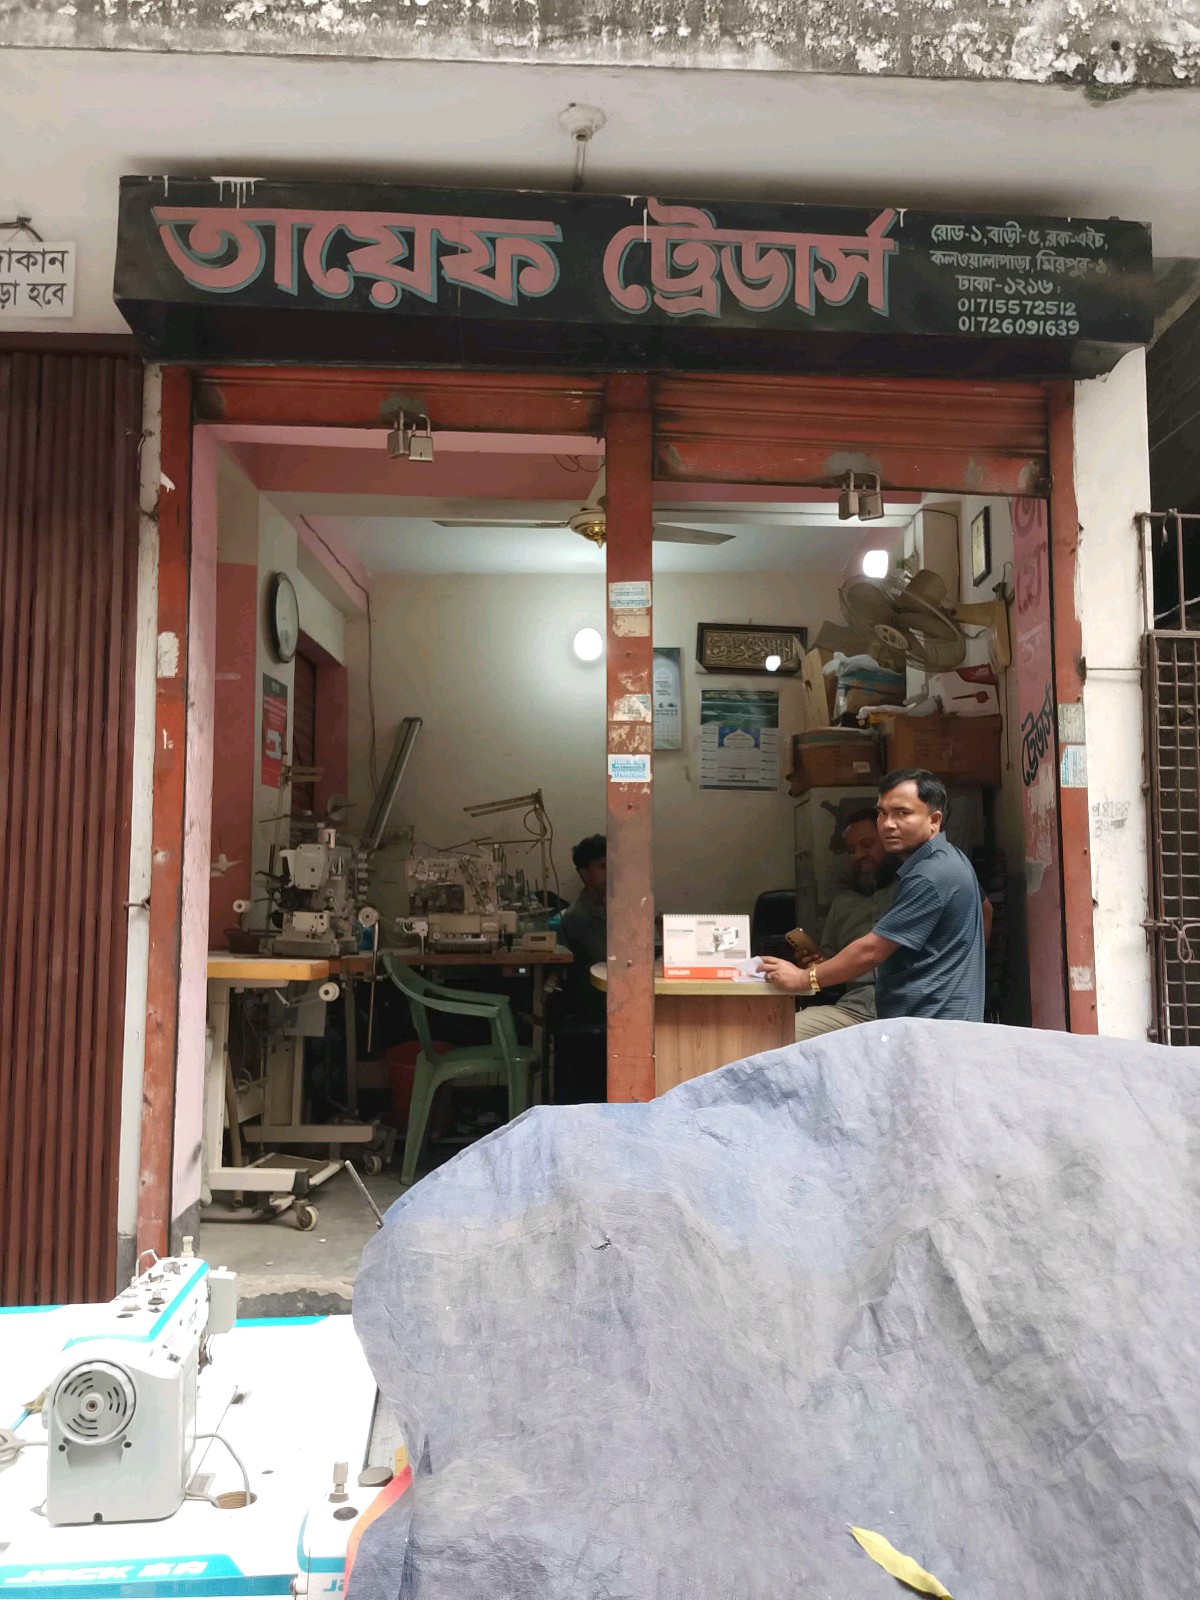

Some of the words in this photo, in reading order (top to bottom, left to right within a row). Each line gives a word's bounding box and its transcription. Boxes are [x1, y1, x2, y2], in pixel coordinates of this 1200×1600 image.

[152, 206, 563, 309] তায়েফ
[602, 196, 899, 317] ট্রেডার্স
[26, 283, 67, 309] হবে
[957, 299, 1077, 316] 01715572512
[958, 316, 1080, 337] 01726091639
